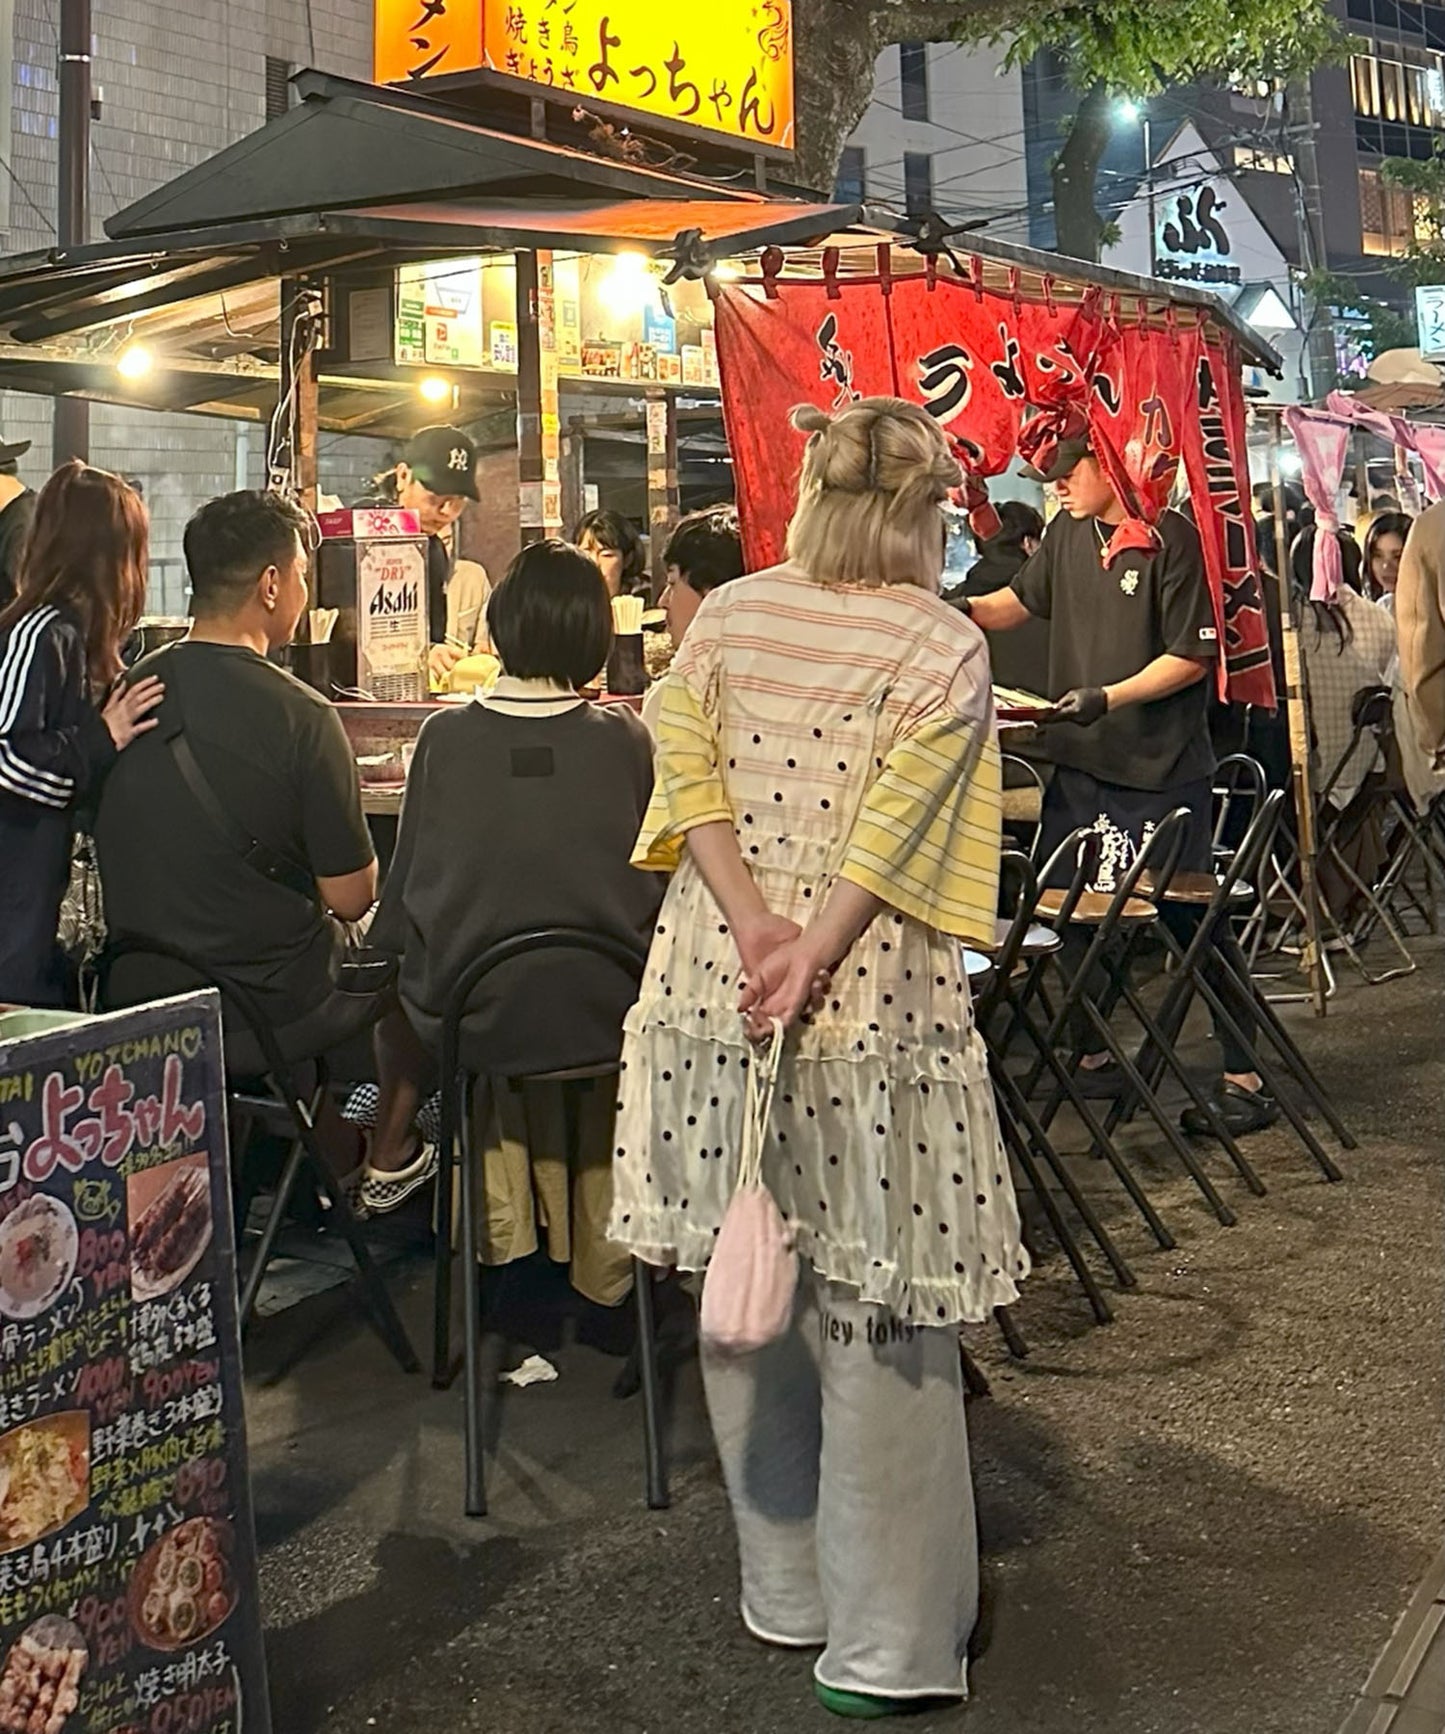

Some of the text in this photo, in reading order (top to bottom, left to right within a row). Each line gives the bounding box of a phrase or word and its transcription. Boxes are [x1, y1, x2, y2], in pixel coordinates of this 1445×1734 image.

[505, 5, 579, 57] 焼き鳥
[587, 15, 775, 136] よっちゃん
[369, 581, 419, 616] Asahi
[73, 1031, 180, 1084] YOTCHAN
[23, 1052, 205, 1183] よっちゃん
[0, 1302, 80, 1362] 骨ラーメン
[134, 1640, 231, 1710] 焼き明太子
